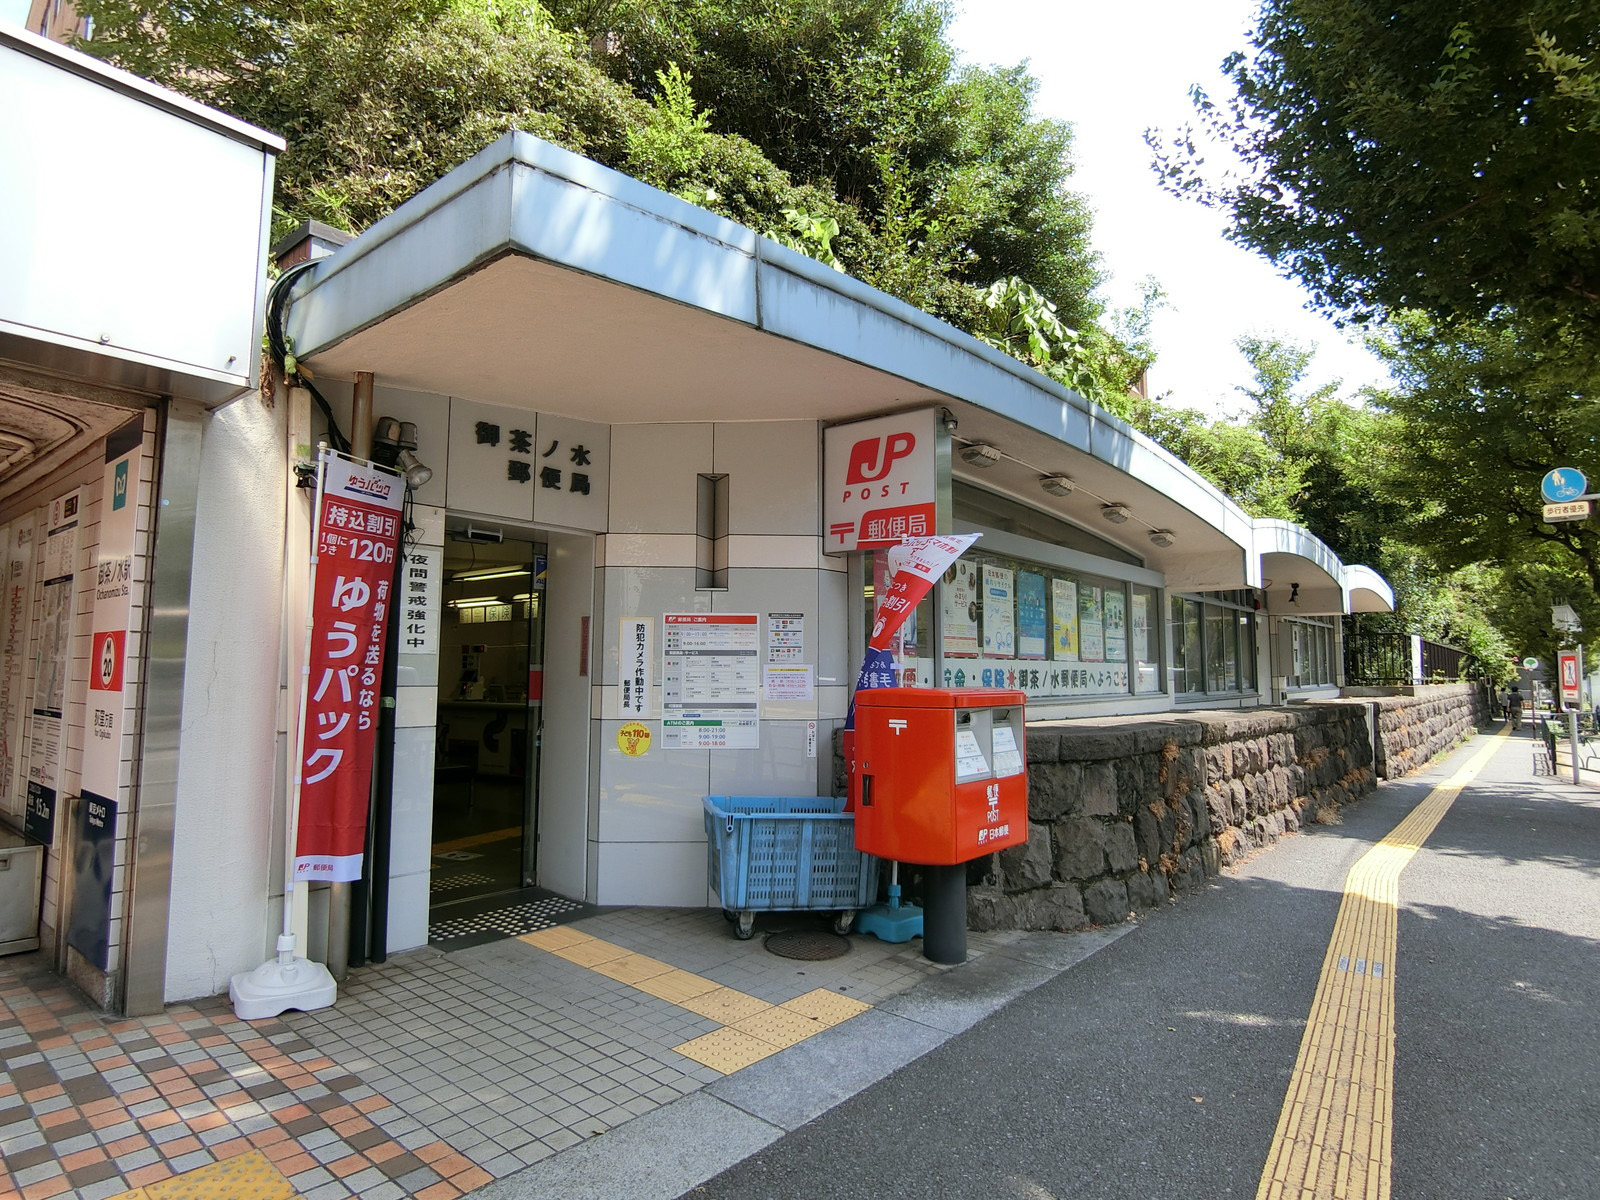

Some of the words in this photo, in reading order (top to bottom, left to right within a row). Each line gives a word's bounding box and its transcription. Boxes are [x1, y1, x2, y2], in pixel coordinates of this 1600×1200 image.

[475, 421, 591, 466] 御茶ノ水
[846, 432, 916, 485] JP
[349, 474, 391, 496] ゆうパック
[507, 460, 591, 496] 郵便局
[843, 482, 909, 503] POST
[328, 505, 396, 537] 持込割引
[1546, 504, 1585, 516] 歩行者優先
[321, 532, 348, 546] 1個に
[867, 513, 927, 540] 郵便局
[320, 545, 337, 556] つき
[349, 538, 394, 564] 120円
[98, 555, 131, 586] 御茶ノ水駅
[406, 554, 428, 648] 夜間警戒強化中
[103, 658, 112, 677] 20
[358, 579, 390, 730] 荷物を送るなら
[634, 623, 645, 713] 防犯カメラ作動中です
[306, 576, 371, 785] ゆうパック
[981, 668, 1005, 688] 保険
[1018, 668, 1128, 690] 御茶ノ水郵便局へようこそ
[623, 679, 631, 708] 郵便局長
[986, 784, 999, 798] 郵便
[987, 809, 999, 823] POST
[989, 824, 1010, 840] 日本郵便
